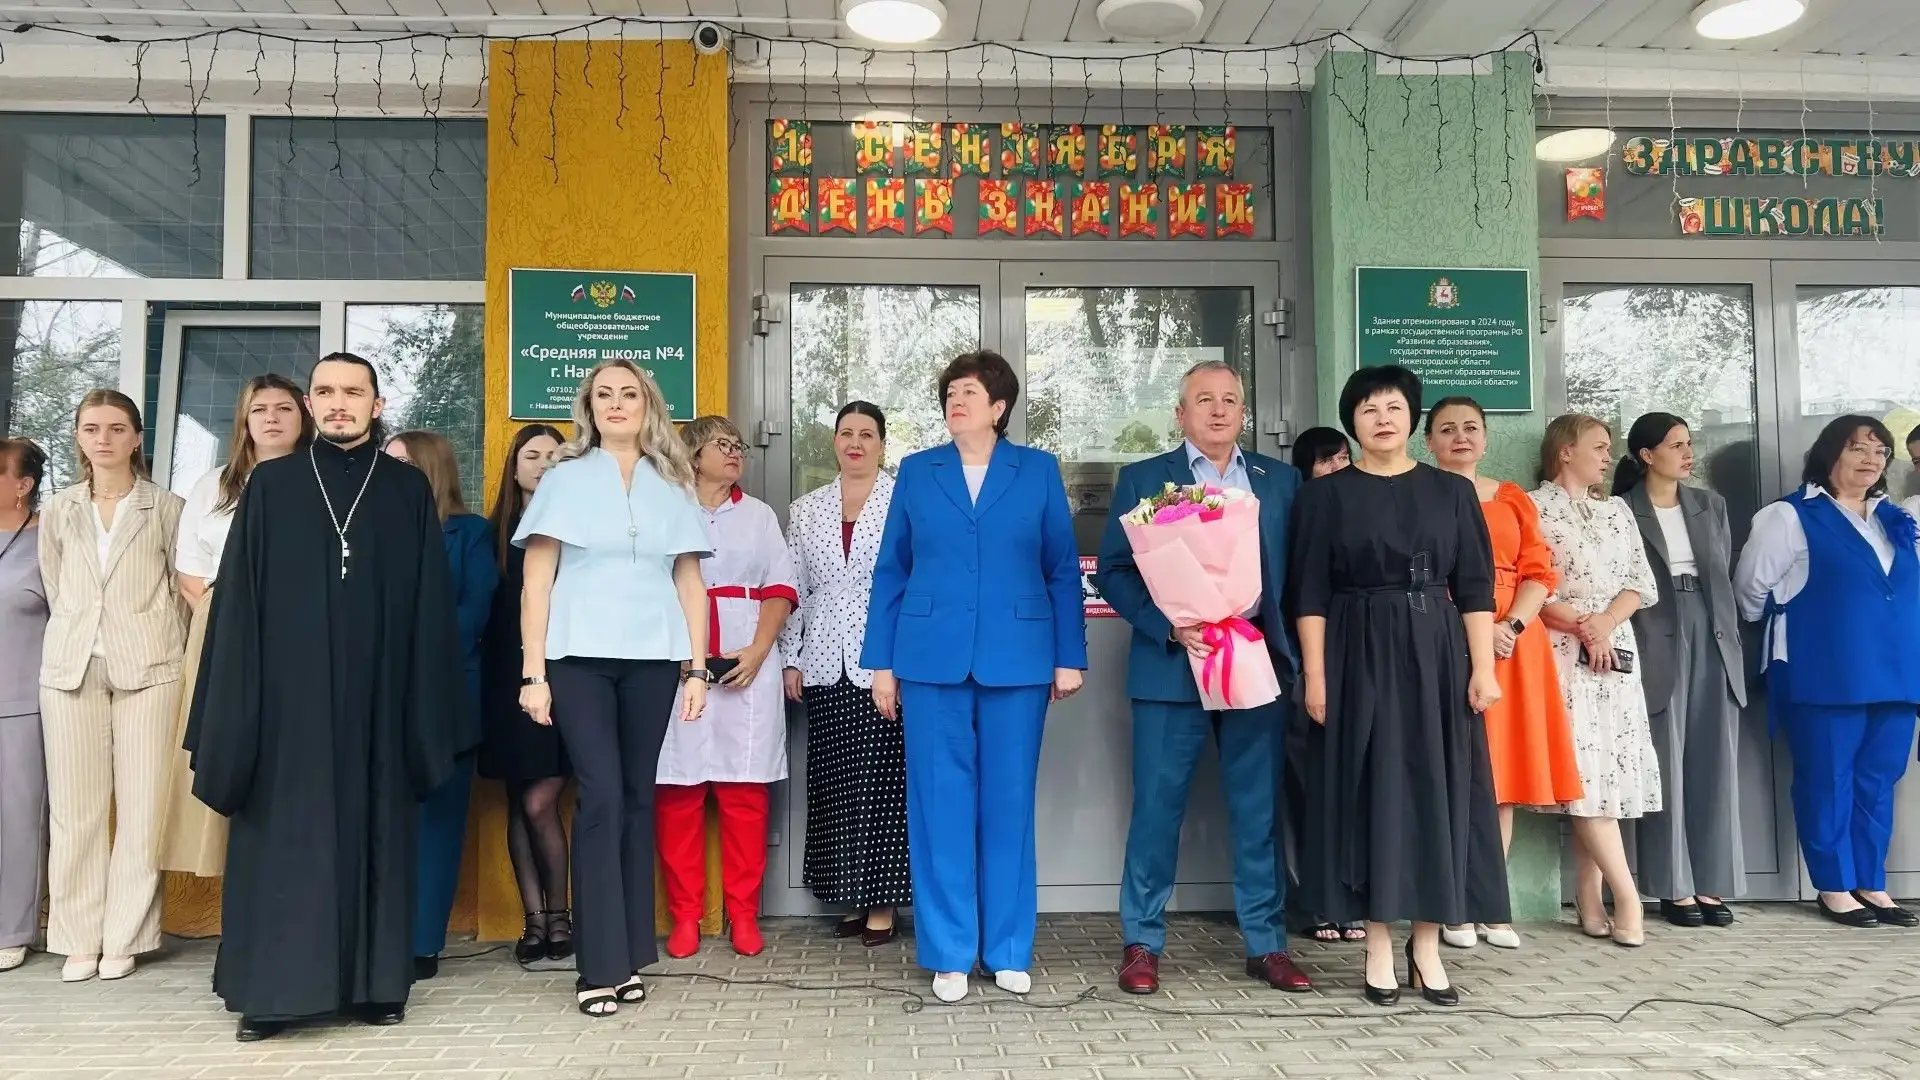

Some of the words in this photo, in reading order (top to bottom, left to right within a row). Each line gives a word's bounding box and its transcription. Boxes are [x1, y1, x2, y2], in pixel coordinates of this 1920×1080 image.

[784, 129, 797, 162] 1
[864, 130, 1226, 167] СЕНТЯБРЯ
[1625, 136, 1920, 177] ЗДРАВСТВУ
[778, 188, 944, 221] ДЕНЬ
[1703, 196, 1885, 235] ШКОЛА!
[545, 311, 612, 321] Муниципальное
[613, 312, 661, 322] бюджетное
[1372, 316, 1401, 326] Здание
[1402, 318, 1470, 327] отремонтировано
[1478, 317, 1497, 326] 2024
[1498, 319, 1516, 328] году
[556, 321, 650, 332] общеобразовательное
[1371, 328, 1400, 336] рамках
[1401, 327, 1465, 337] государственной
[1466, 328, 1510, 337] программы
[1511, 328, 1524, 336] РФ
[577, 332, 629, 341] учреждение
[1396, 337, 1436, 345] «Развитие
[520, 344, 597, 361] «Средняя
[602, 349, 651, 360] школа
[655, 346, 685, 361] №4
[1389, 347, 1454, 357] государственной
[1455, 349, 1499, 357] программы
[1398, 357, 1459, 366] Нижегородской
[1460, 357, 1491, 366] области
[550, 367, 561, 378] г.
[1454, 368, 1521, 377] образовательных
[1422, 377, 1482, 387] Нижегородской
[1484, 378, 1519, 387] области»
[546, 386, 575, 395] 607102,
